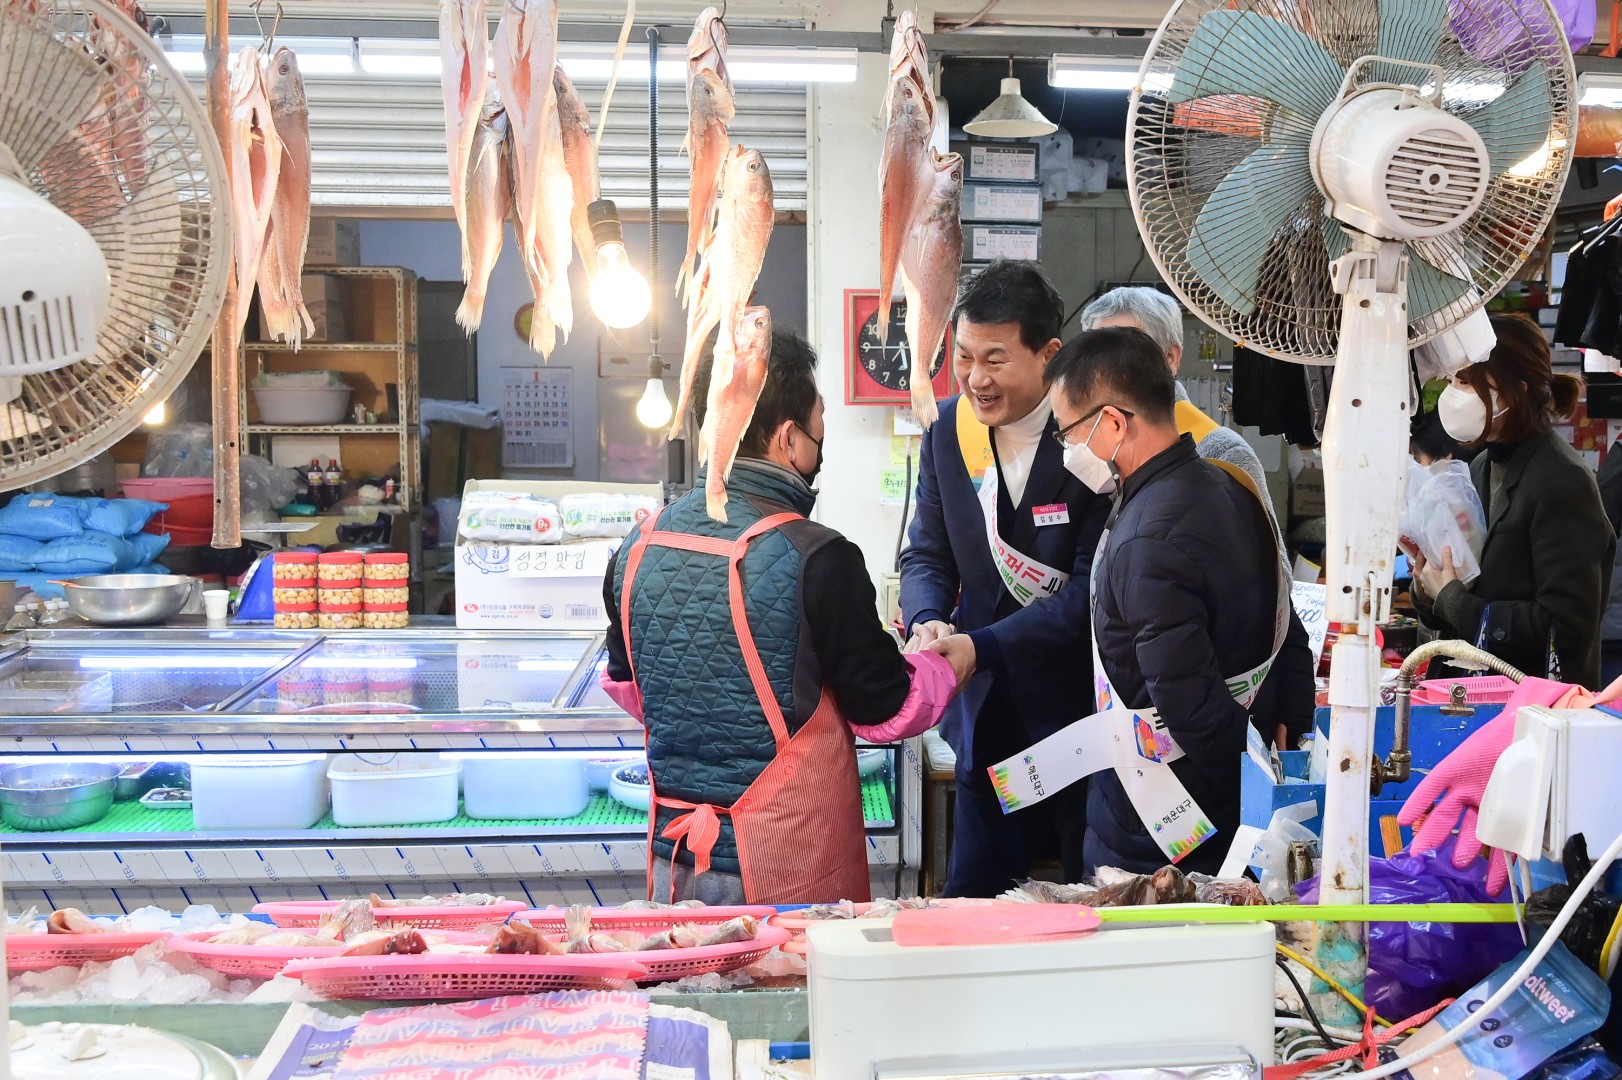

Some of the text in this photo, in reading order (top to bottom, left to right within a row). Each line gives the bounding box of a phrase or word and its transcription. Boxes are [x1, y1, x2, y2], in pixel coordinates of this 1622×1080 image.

[863, 342, 871, 352] 9
[868, 359, 876, 370] 8
[883, 372, 890, 382] 7
[899, 376, 907, 387] 6
[556, 550, 586, 570] 맛김
[1028, 765, 1045, 797] 해운대구
[1162, 799, 1192, 824] 해운대구
[1523, 974, 1576, 1024] altweet
